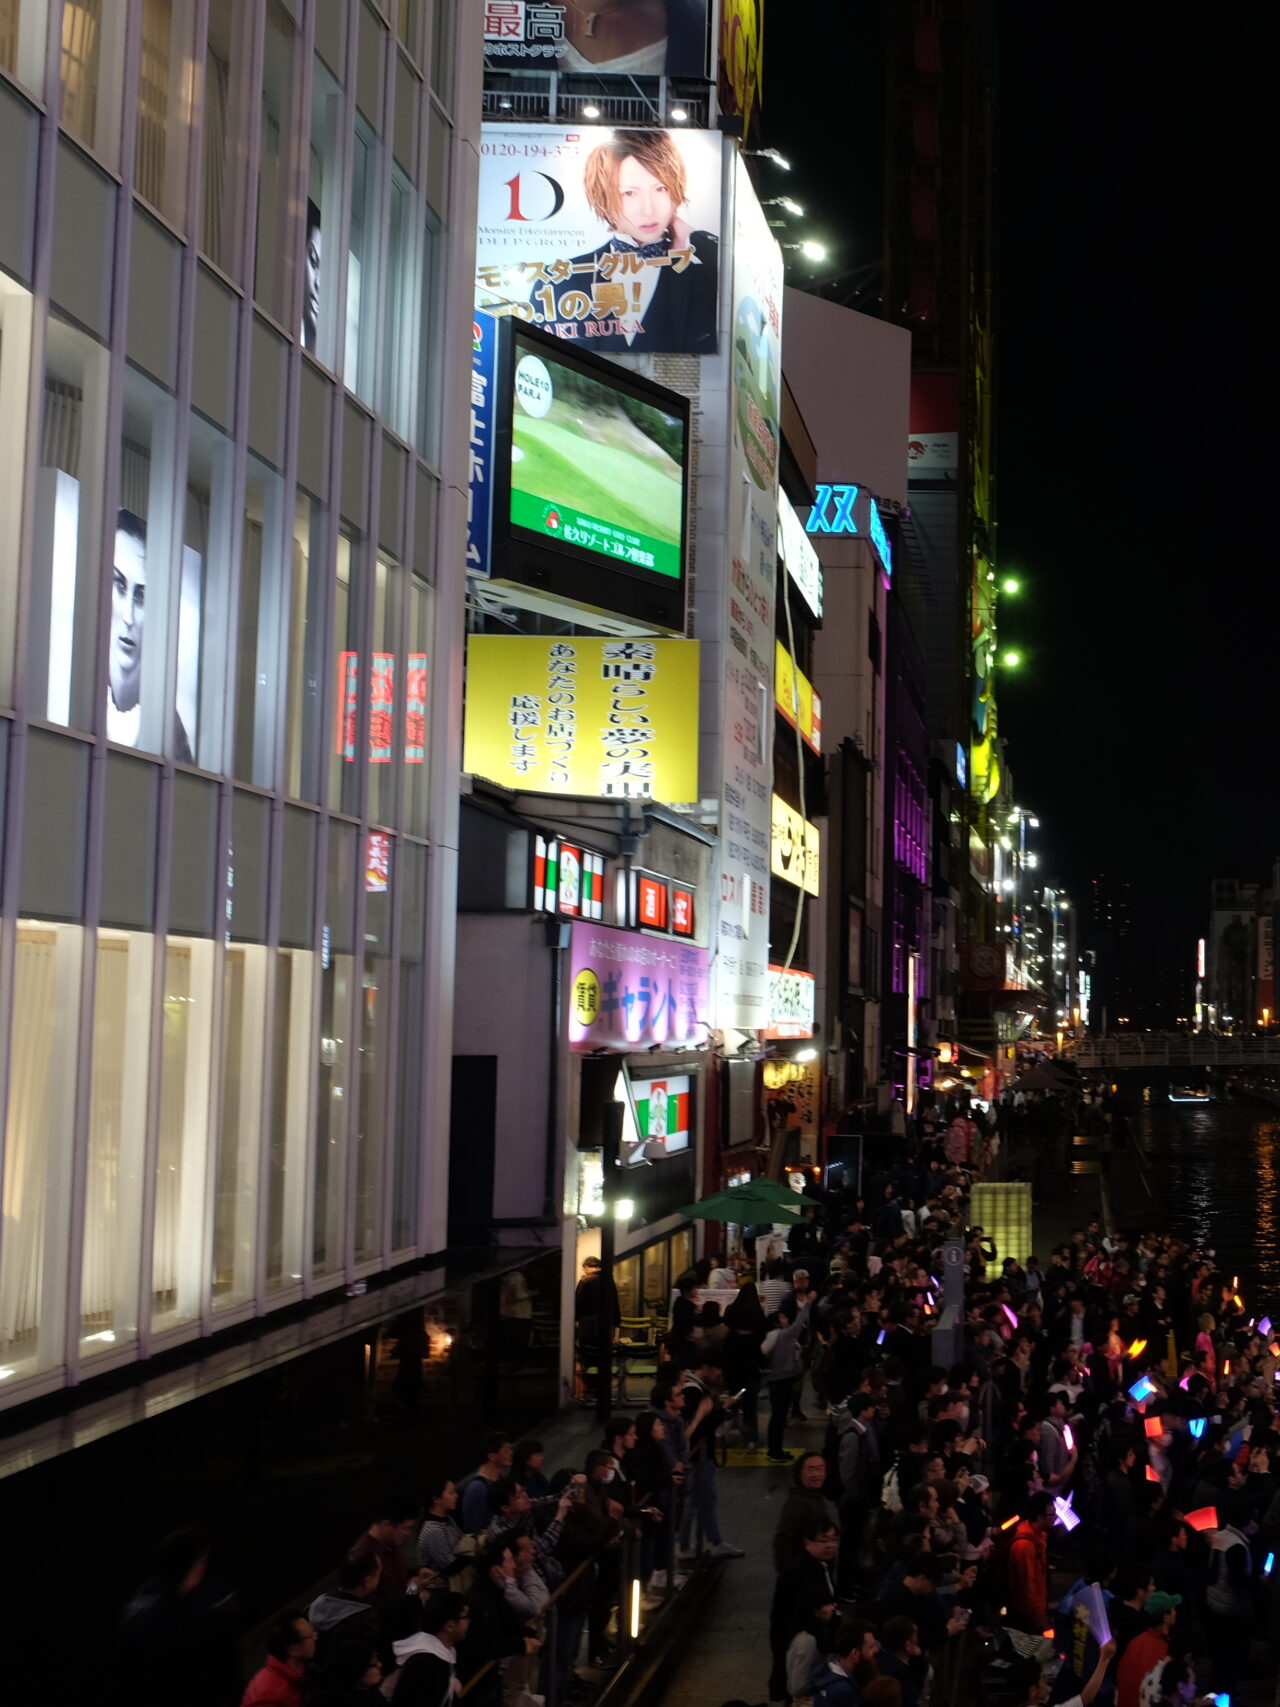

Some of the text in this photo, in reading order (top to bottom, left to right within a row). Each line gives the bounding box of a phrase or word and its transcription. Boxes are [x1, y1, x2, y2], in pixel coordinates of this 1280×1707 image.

[484, 2, 567, 41] 最高
[584, 320, 646, 338] RUKA
[508, 694, 541, 775] 応援します
[545, 642, 577, 785] あなたのお店づくり
